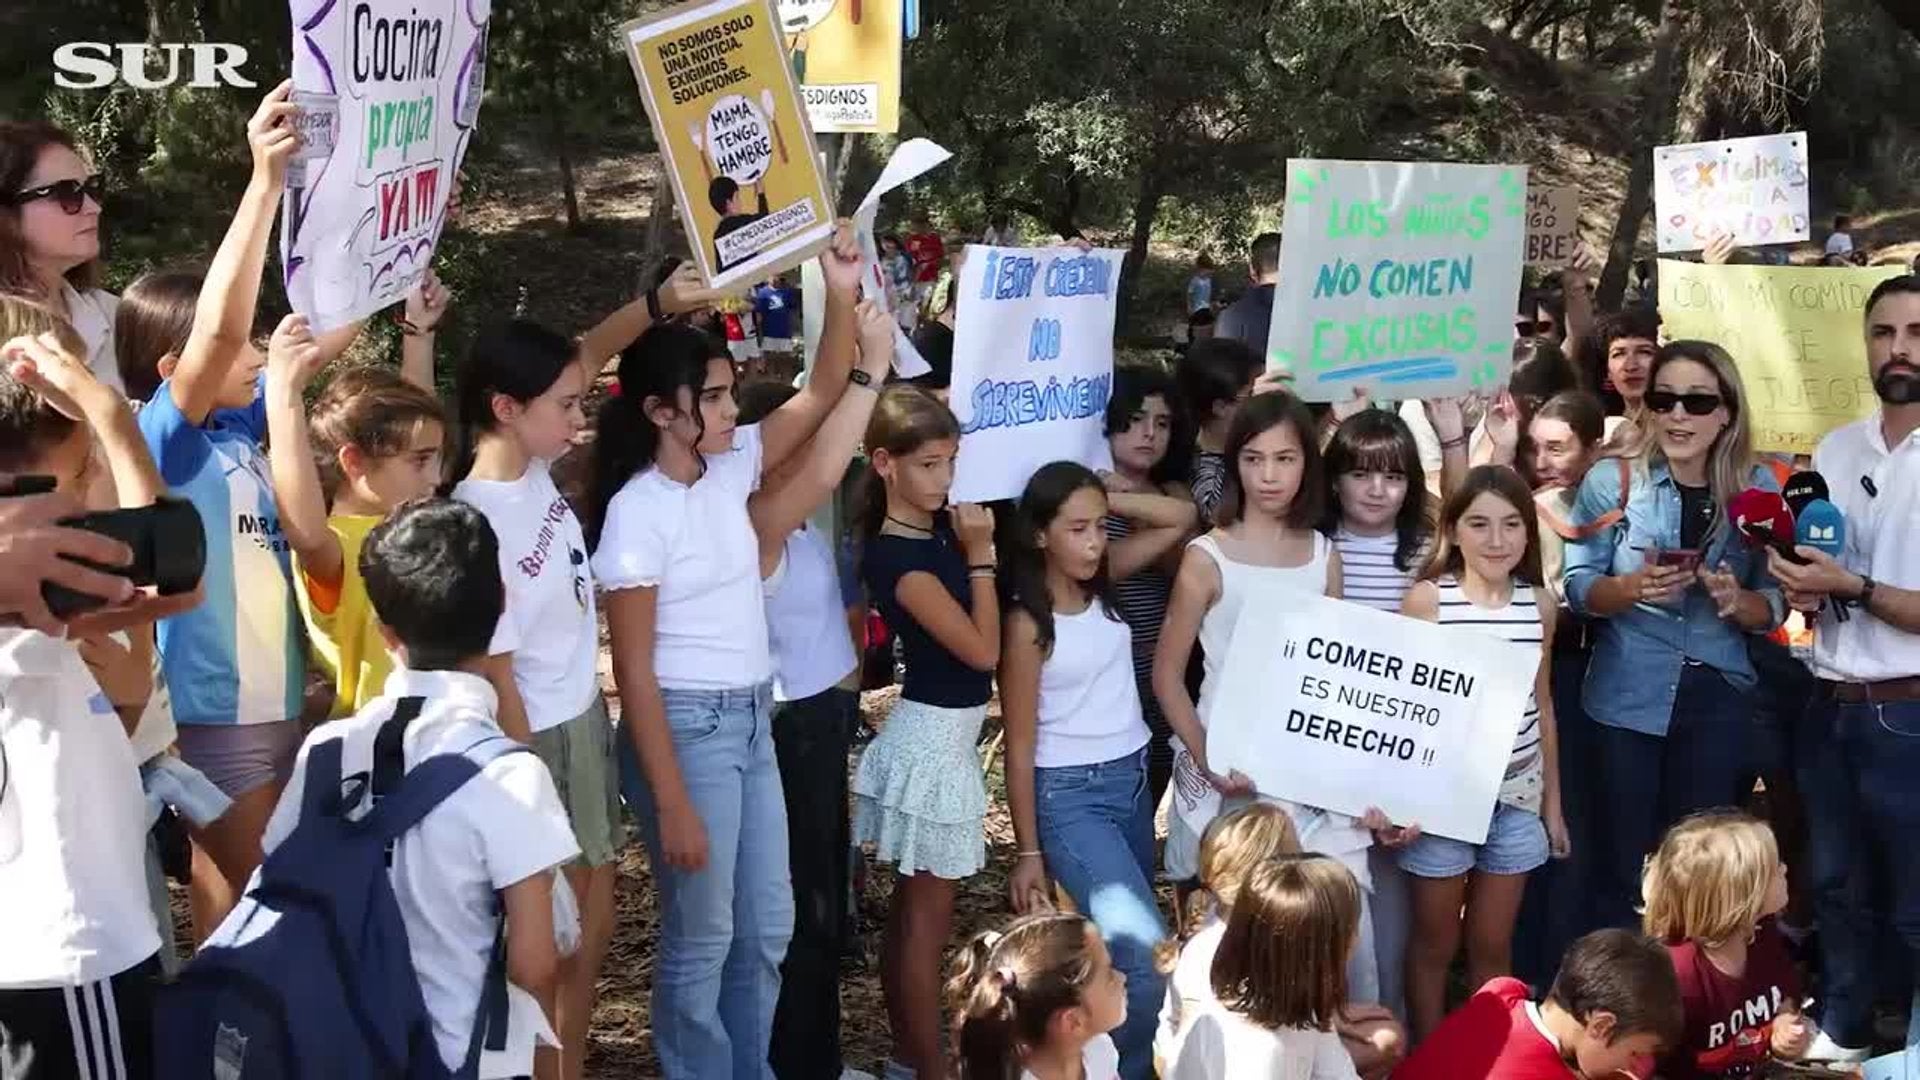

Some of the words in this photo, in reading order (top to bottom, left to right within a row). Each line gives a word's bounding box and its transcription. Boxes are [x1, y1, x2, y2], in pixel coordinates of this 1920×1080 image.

[353, 3, 442, 83] Cocina
[658, 42, 678, 60] NO
[678, 26, 722, 53] SOMOS
[722, 14, 754, 36] SOLO
[663, 55, 692, 75] UNA
[690, 36, 743, 63] NOTICIA.
[667, 58, 728, 90] EXIGIMOS
[672, 66, 751, 105] SOLUCIONES.
[367, 96, 433, 168] propia
[714, 121, 759, 151] TENGO
[717, 136, 772, 174] HAMBRE
[1326, 197, 1389, 239] LOS
[1404, 193, 1490, 241] NIÑOS
[1313, 257, 1361, 299] NO
[1368, 254, 1473, 299] COMEN
[1790, 282, 1868, 312] COMID
[1028, 318, 1062, 362] NO
[1310, 304, 1477, 370] EXCUSAS
[1306, 637, 1403, 681] COMER
[1410, 662, 1475, 698] BIEN
[1300, 675, 1331, 700] ES
[1336, 685, 1440, 727] NUESTRO
[1285, 709, 1415, 761] DERECHO
